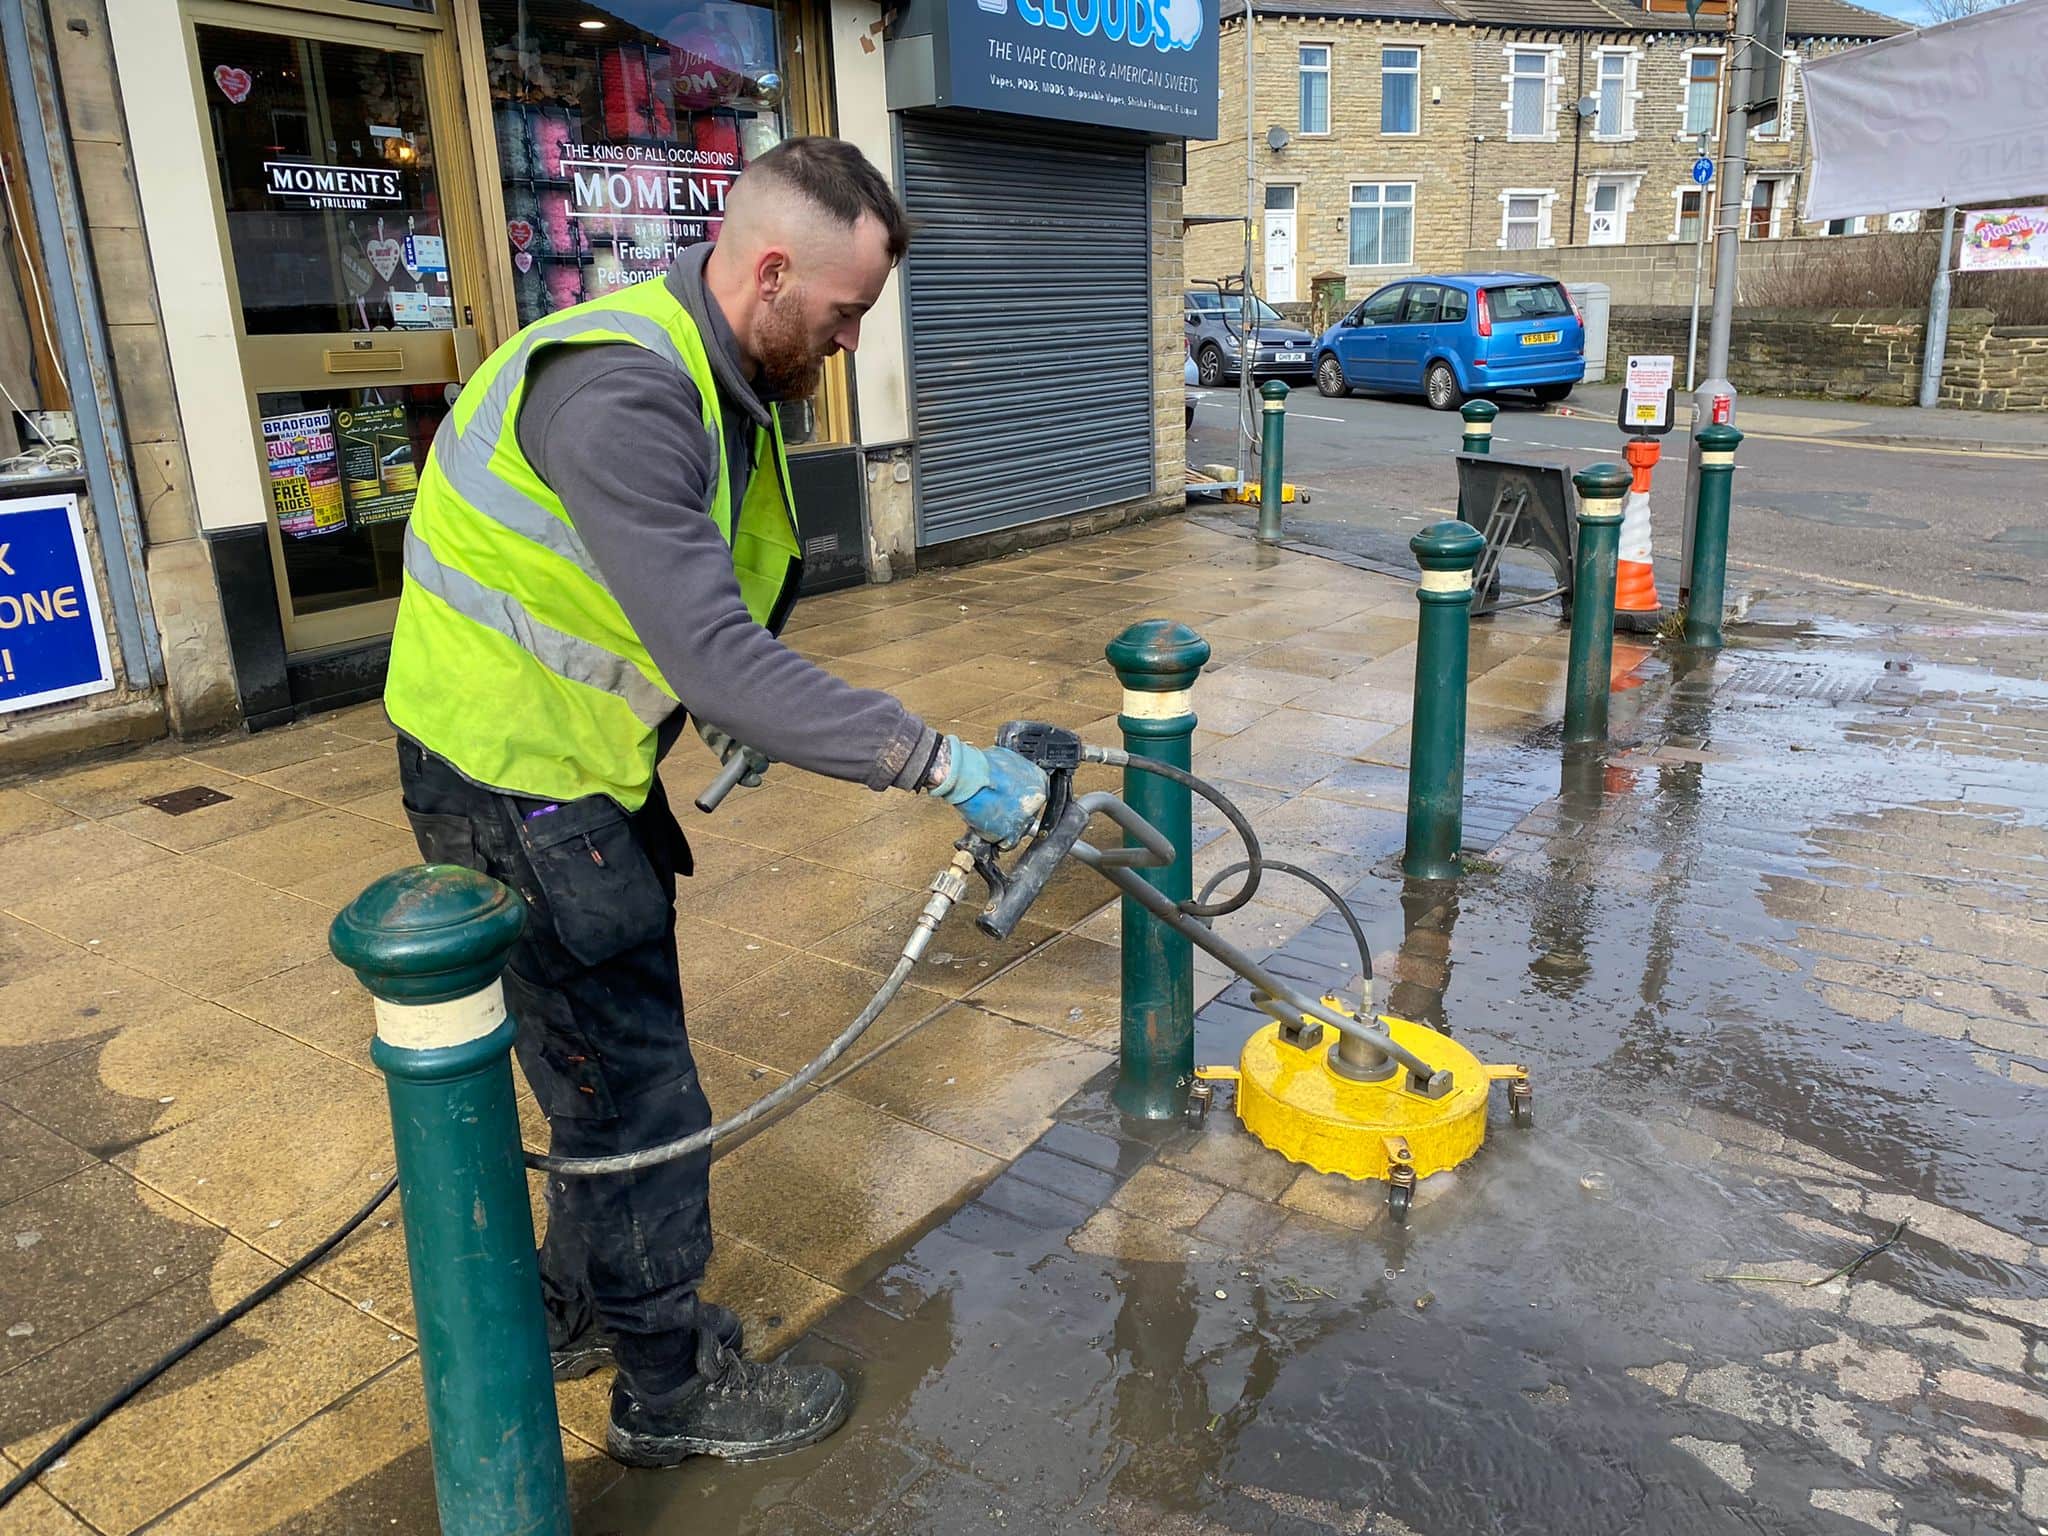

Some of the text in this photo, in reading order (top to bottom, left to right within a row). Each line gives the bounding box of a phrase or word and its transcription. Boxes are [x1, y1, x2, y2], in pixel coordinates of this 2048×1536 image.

[988, 38, 1198, 93] THE VAPE CORNER & AMERICAN SWEETS
[1068, 86, 1104, 101] Disposable
[563, 143, 734, 166] THE KING OF ALL OCCASIONS
[272, 168, 396, 195] MOMENTS
[309, 197, 367, 209] by TRILLIONZ
[634, 223, 702, 239] by TRILLIONZ
[619, 242, 661, 260] Fresh
[263, 415, 329, 433] BRADFORD
[267, 433, 334, 457] FUN FAIR
[273, 483, 308, 500] FREE
[275, 497, 311, 512] RIDES
